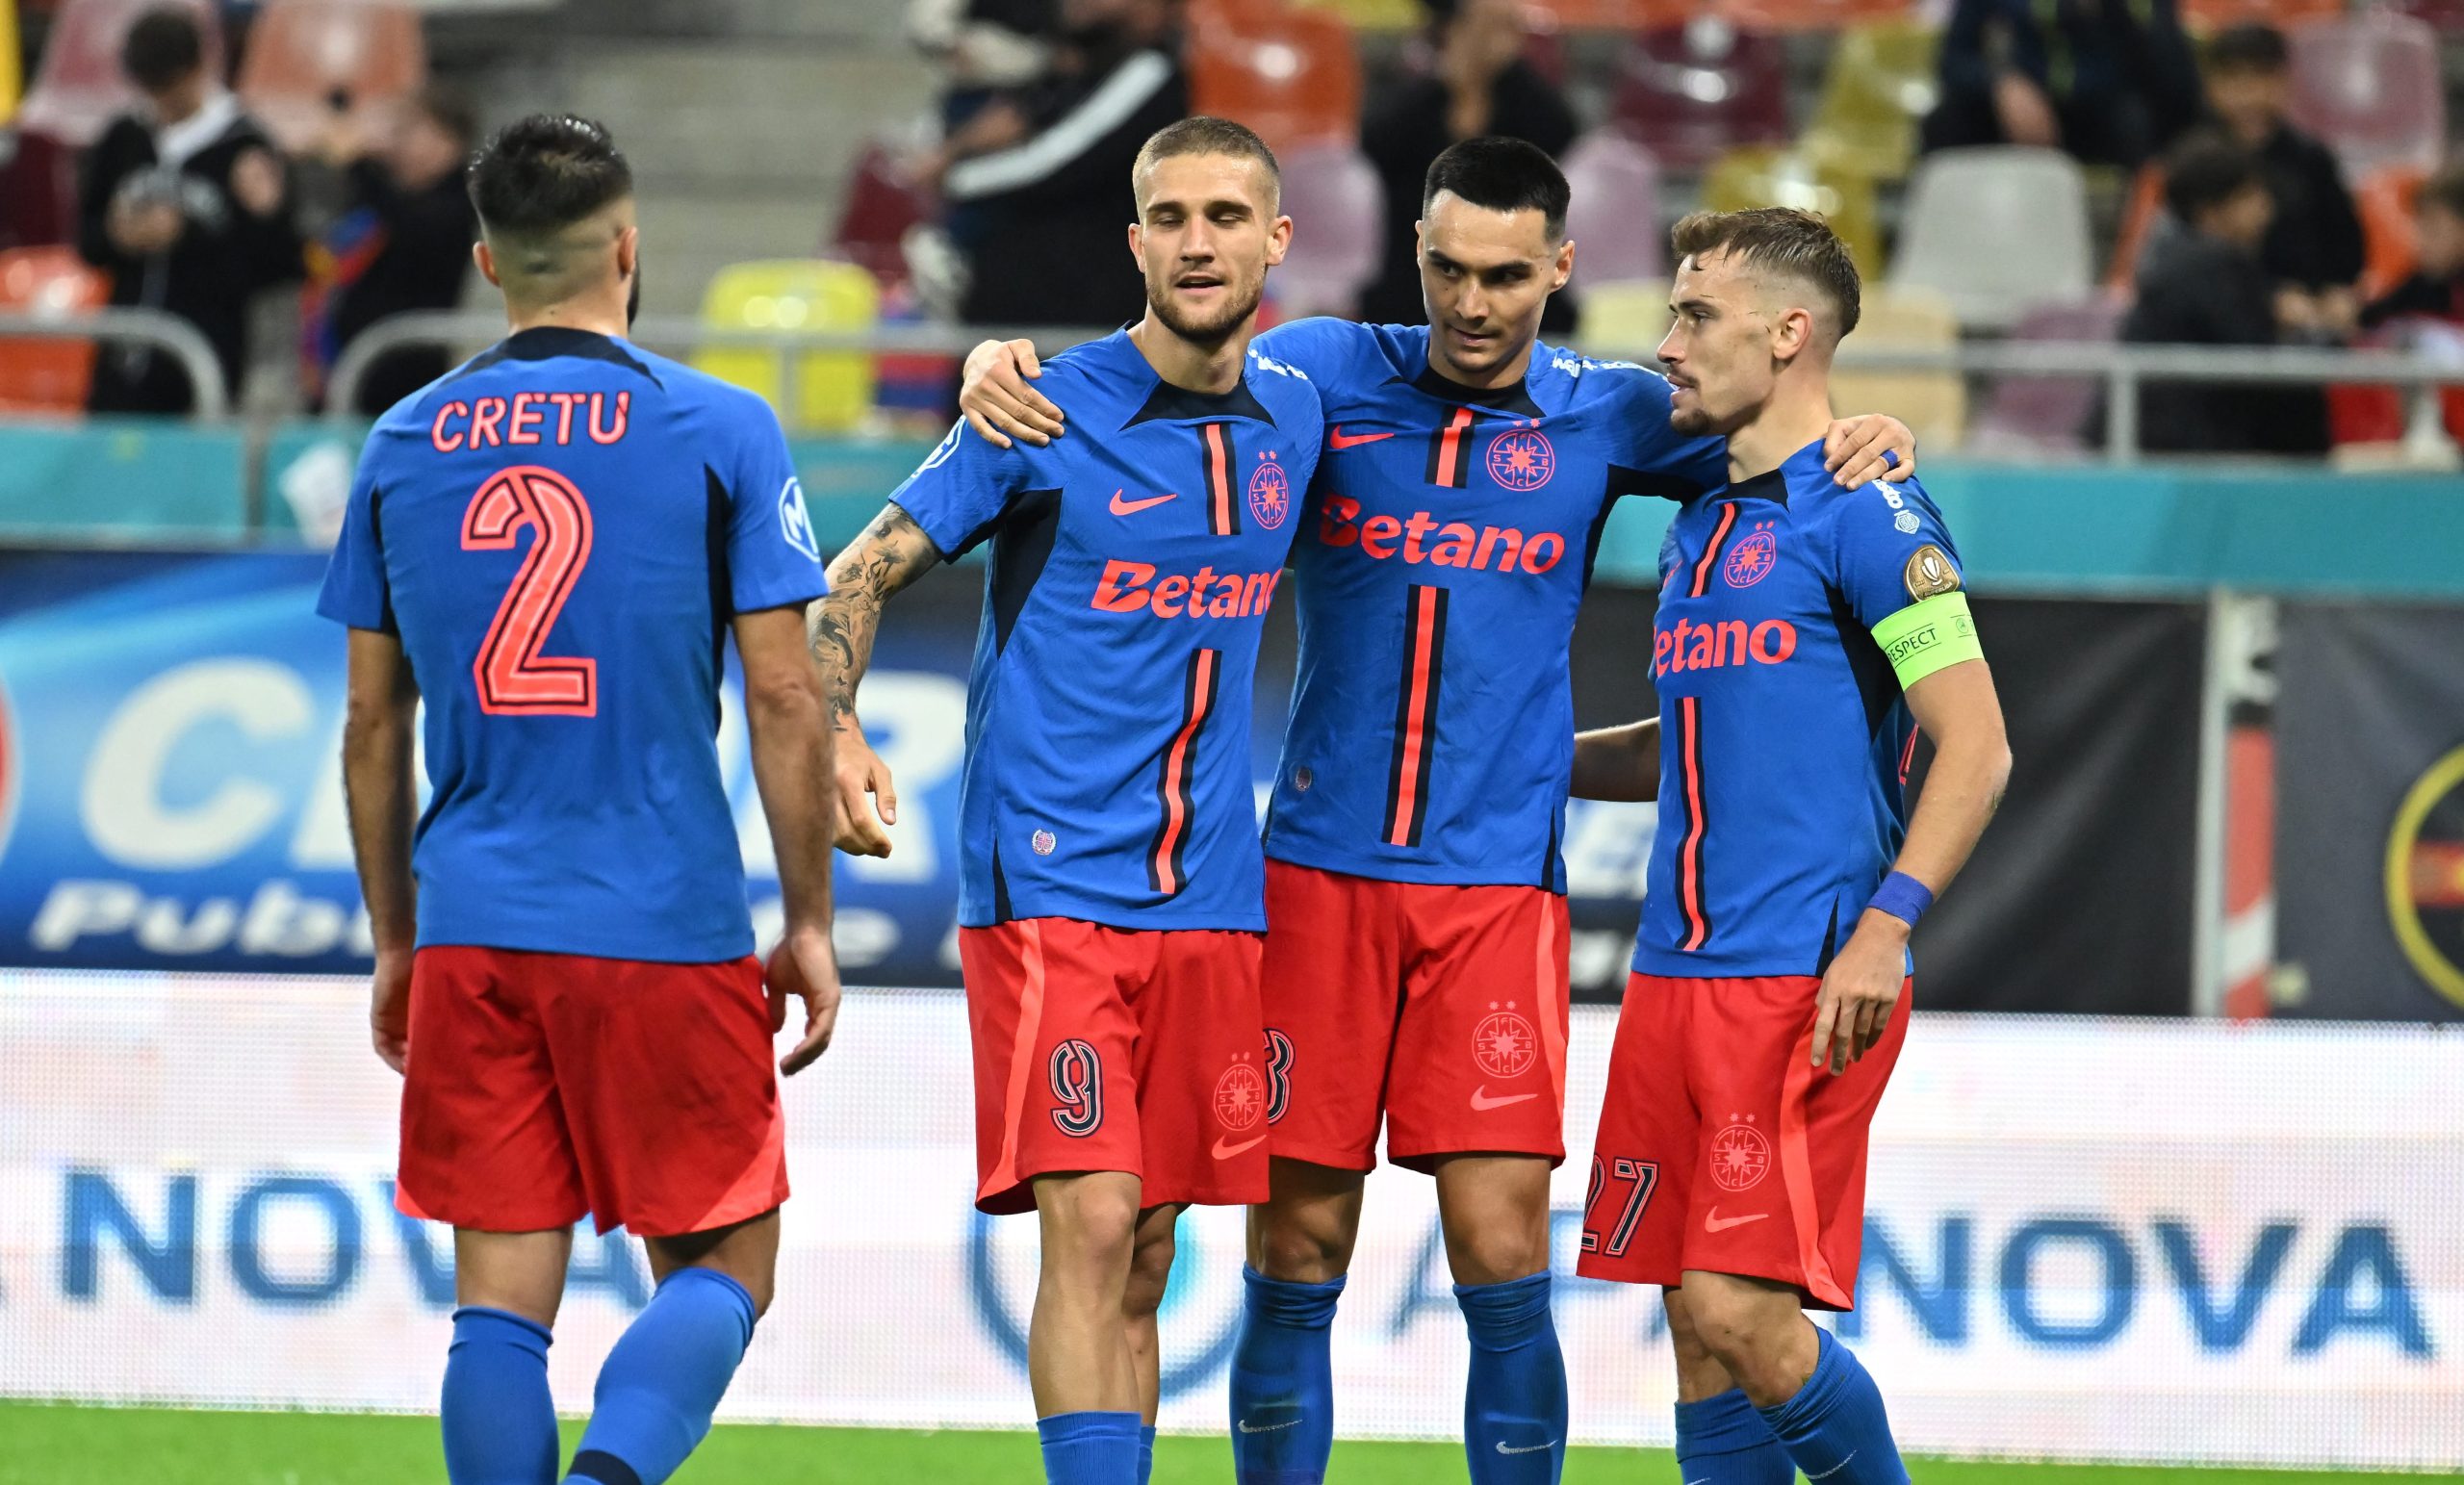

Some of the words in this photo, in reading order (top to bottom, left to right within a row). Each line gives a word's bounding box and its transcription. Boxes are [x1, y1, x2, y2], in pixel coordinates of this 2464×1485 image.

[432, 391, 630, 453] CRETU
[1319, 491, 1565, 576] Betano
[460, 464, 598, 718] 2
[1091, 558, 1283, 619] Betan
[1653, 617, 1798, 678] etano
[1887, 627, 1938, 663] RESPECT
[1047, 1037, 1105, 1139] 9
[1835, 1215, 2439, 1359] NOVA
